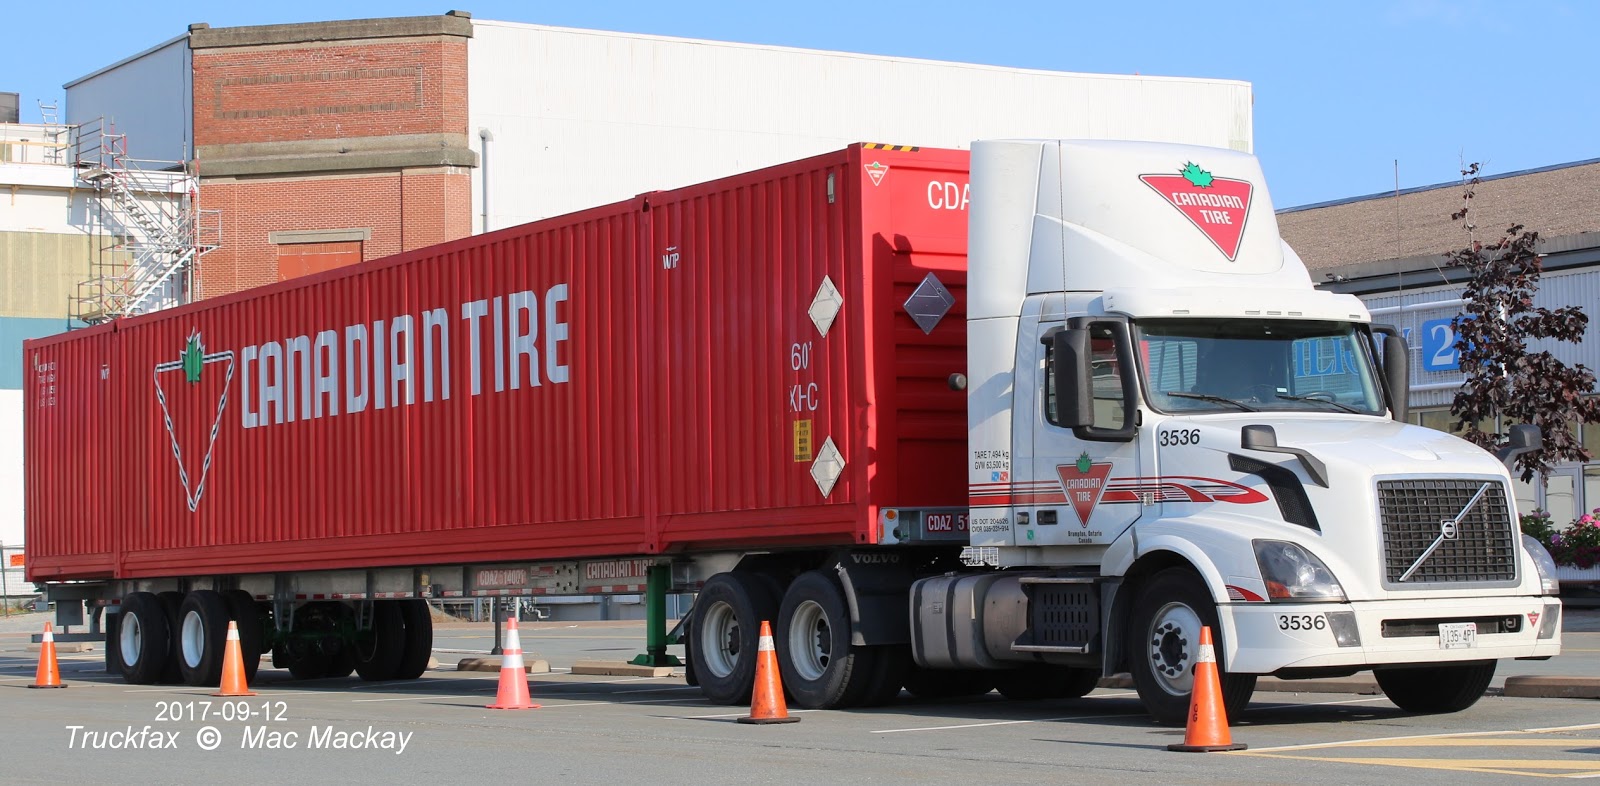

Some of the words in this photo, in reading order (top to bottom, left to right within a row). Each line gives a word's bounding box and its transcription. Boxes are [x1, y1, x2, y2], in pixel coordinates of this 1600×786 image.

[928, 181, 969, 210] CDA
[1172, 192, 1244, 209] CANADIAN
[1199, 210, 1232, 224] TIRE
[242, 308, 450, 428] CANADIAN
[462, 283, 568, 395] TIRE
[1160, 429, 1201, 446] 3536
[974, 451, 987, 459] TARE
[1067, 478, 1101, 489] CANADIAN
[1076, 491, 1091, 501] TIRE
[928, 515, 952, 531] CDAZ
[851, 553, 900, 564] VOLVO
[587, 560, 632, 579] CANADIAN
[1279, 615, 1326, 631] 3536
